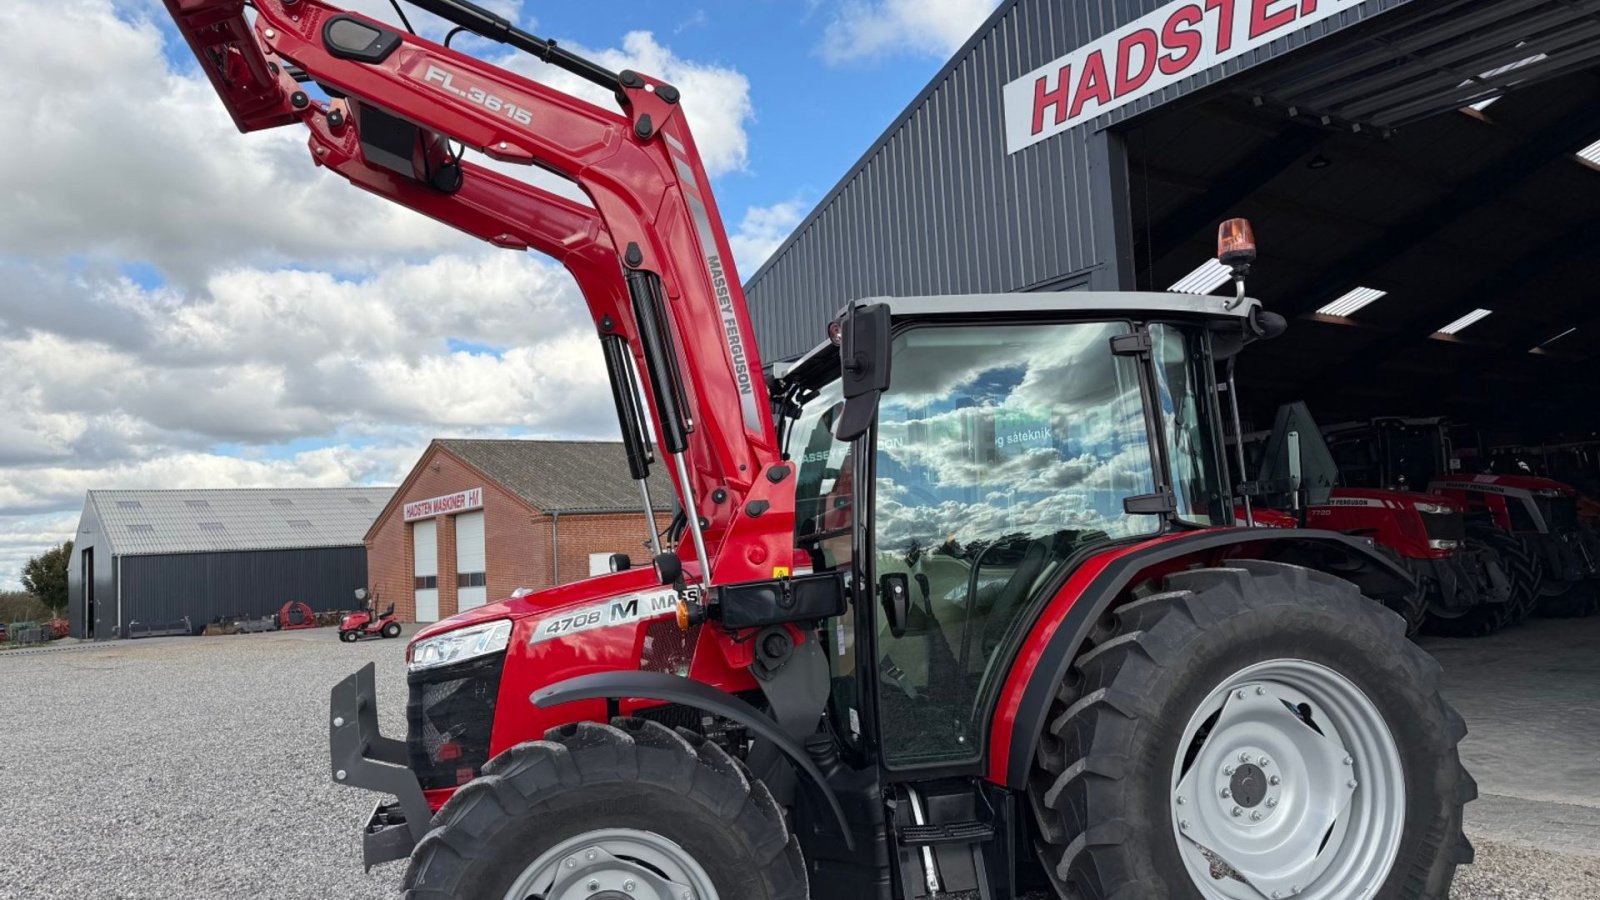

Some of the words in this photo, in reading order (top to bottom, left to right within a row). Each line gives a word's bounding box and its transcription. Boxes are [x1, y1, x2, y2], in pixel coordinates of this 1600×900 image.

[1031, 0, 1340, 136] HADSTE
[424, 64, 533, 125] FL.3615
[707, 255, 733, 314] MASSEY
[724, 318, 751, 395] FERGUSON
[1007, 427, 1051, 444] såteknik
[406, 502, 432, 518] HADSTEN
[433, 494, 465, 513] MASKINER
[1310, 509, 1332, 517] 7720
[546, 611, 601, 634] 4708
[610, 599, 639, 622] M
